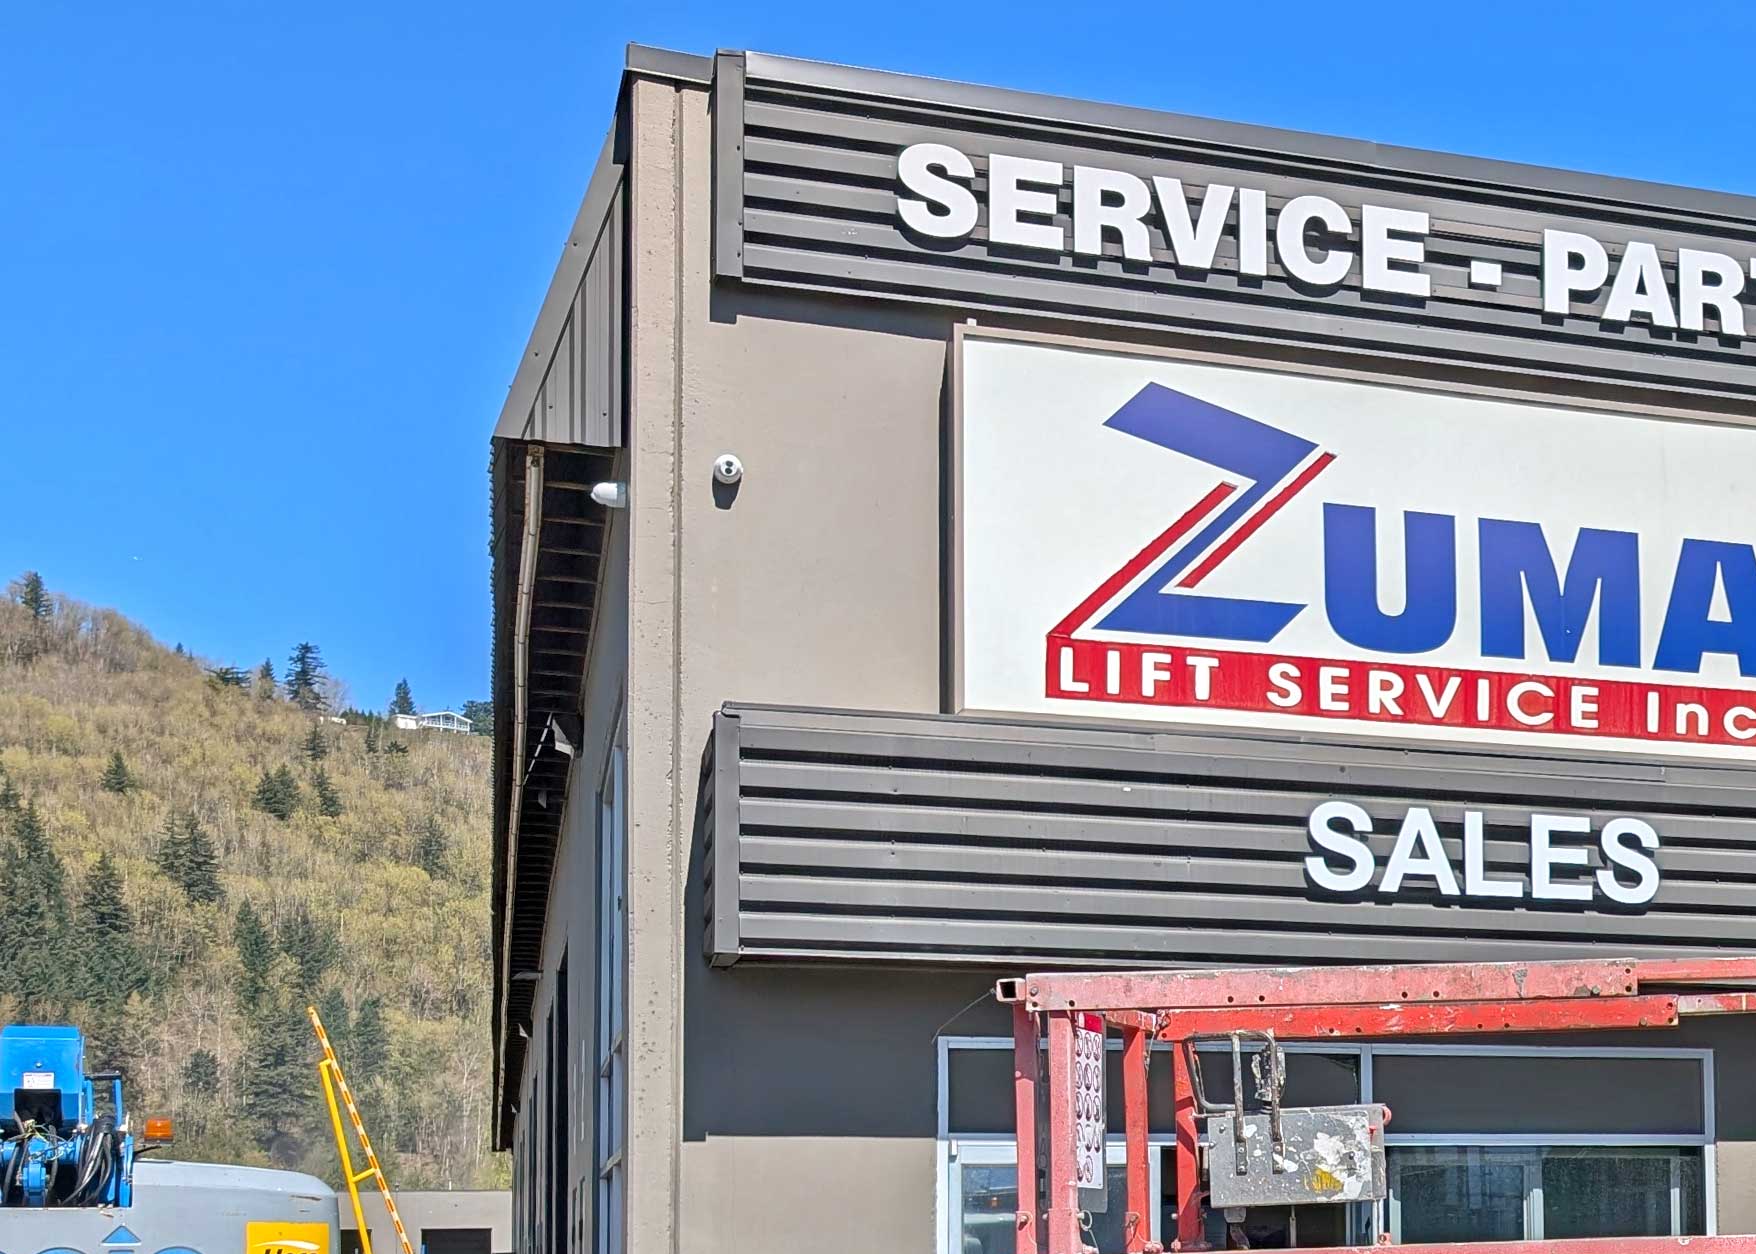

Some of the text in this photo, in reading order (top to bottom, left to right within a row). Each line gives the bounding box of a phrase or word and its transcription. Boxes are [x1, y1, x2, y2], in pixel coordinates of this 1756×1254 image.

[895, 142, 1431, 298] SERVICE
[1058, 645, 1222, 706] LIFT
[1266, 660, 1602, 732] SERVICE
[1304, 801, 1660, 908] SALES
